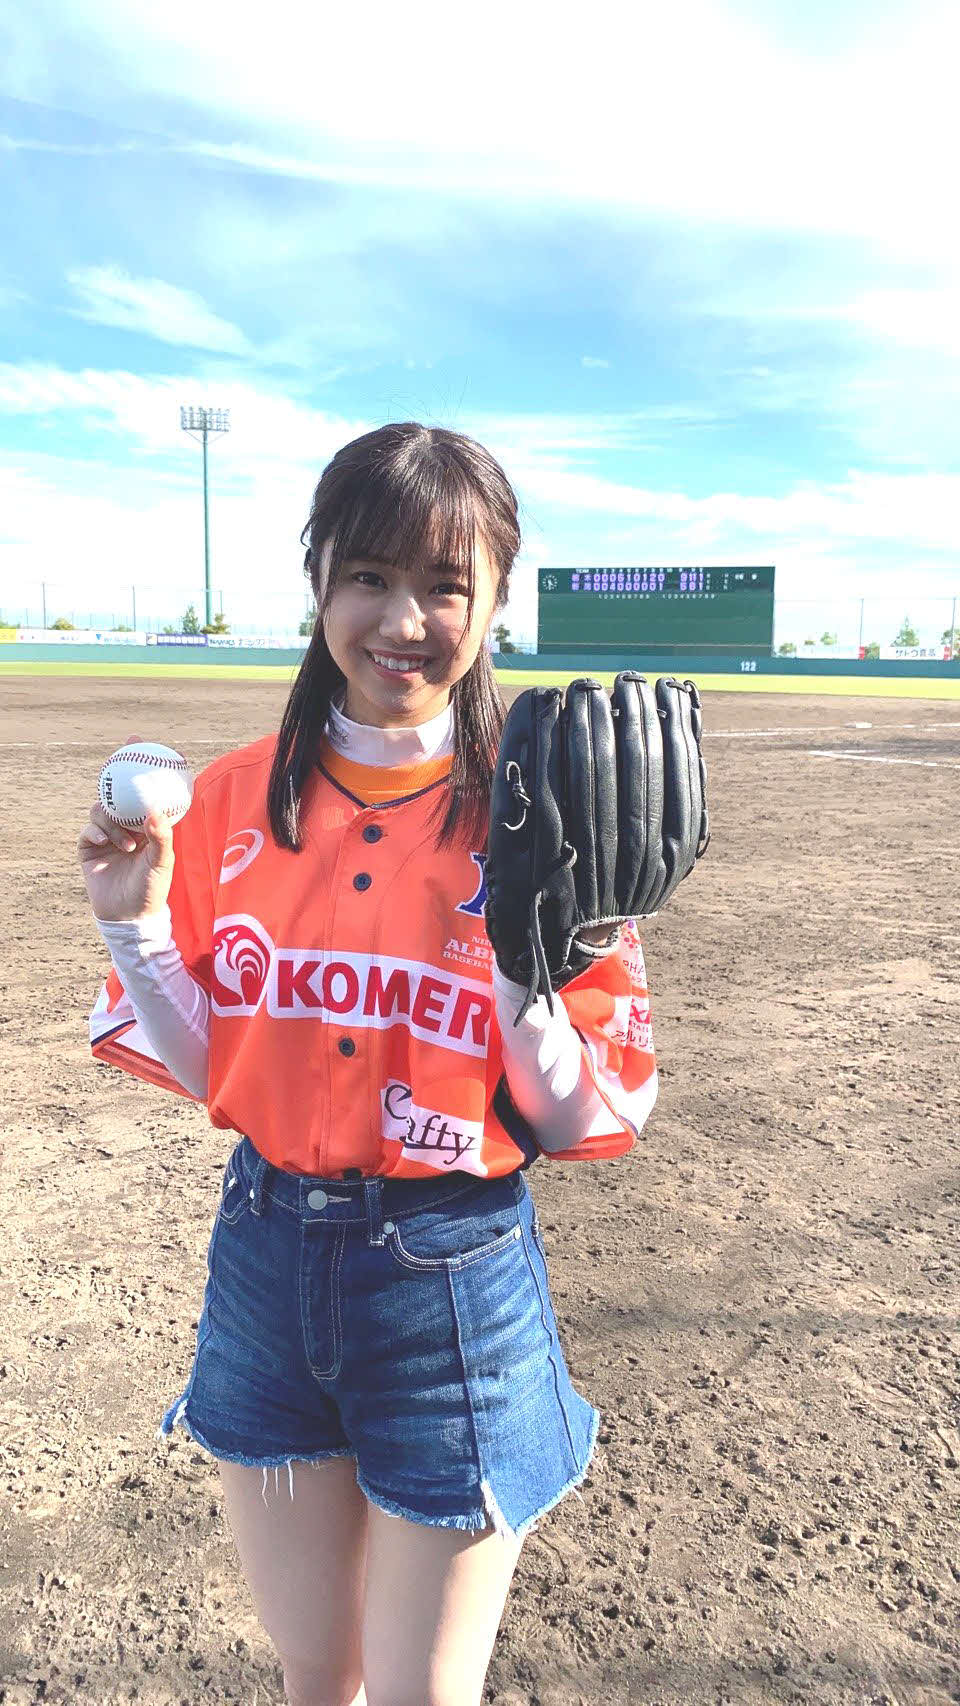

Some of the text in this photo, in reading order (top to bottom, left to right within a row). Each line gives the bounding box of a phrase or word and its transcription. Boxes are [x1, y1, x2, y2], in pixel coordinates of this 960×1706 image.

[740, 661, 756, 671] 122
[444, 938, 493, 961] ALB
[277, 959, 492, 1047] KOMER
